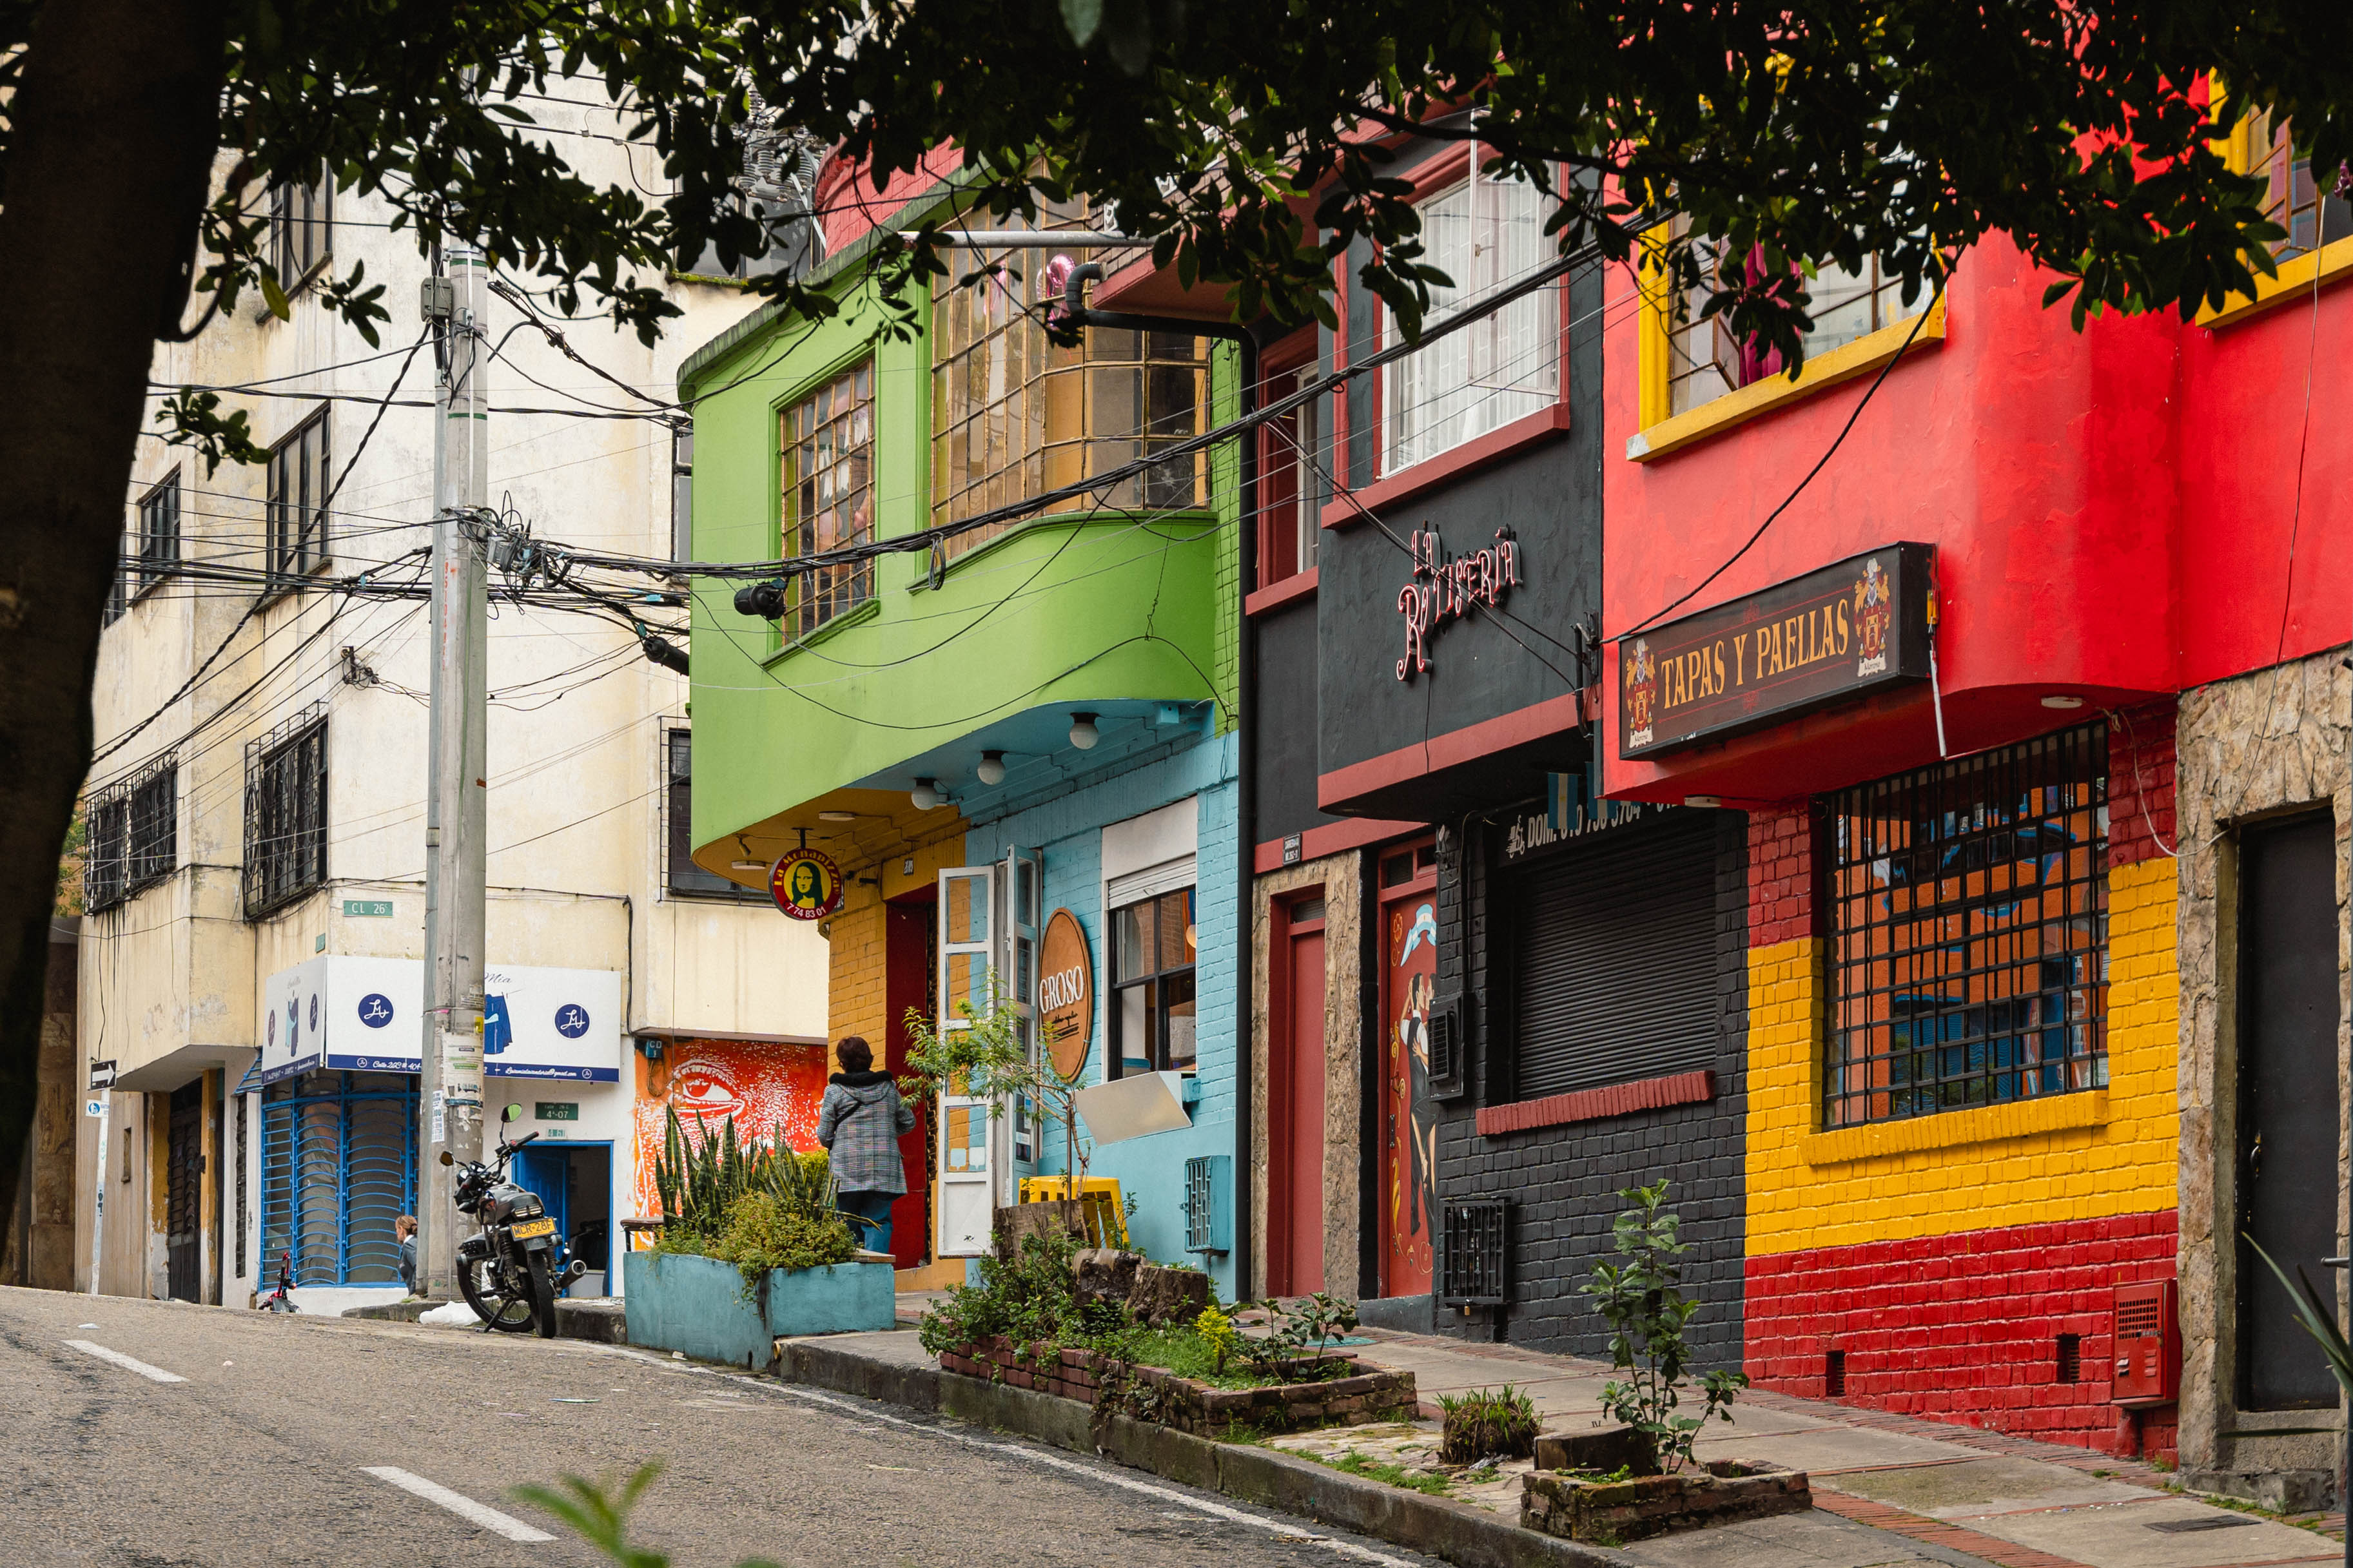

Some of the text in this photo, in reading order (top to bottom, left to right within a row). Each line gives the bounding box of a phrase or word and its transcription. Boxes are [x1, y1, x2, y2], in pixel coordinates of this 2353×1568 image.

[1411, 530, 1435, 576] LA
[1661, 599, 1849, 710] TAPAS Y PAELLAS
[774, 869, 784, 886] La
[1039, 965, 1084, 1014] GROSO
[649, 1040, 662, 1049] CD
